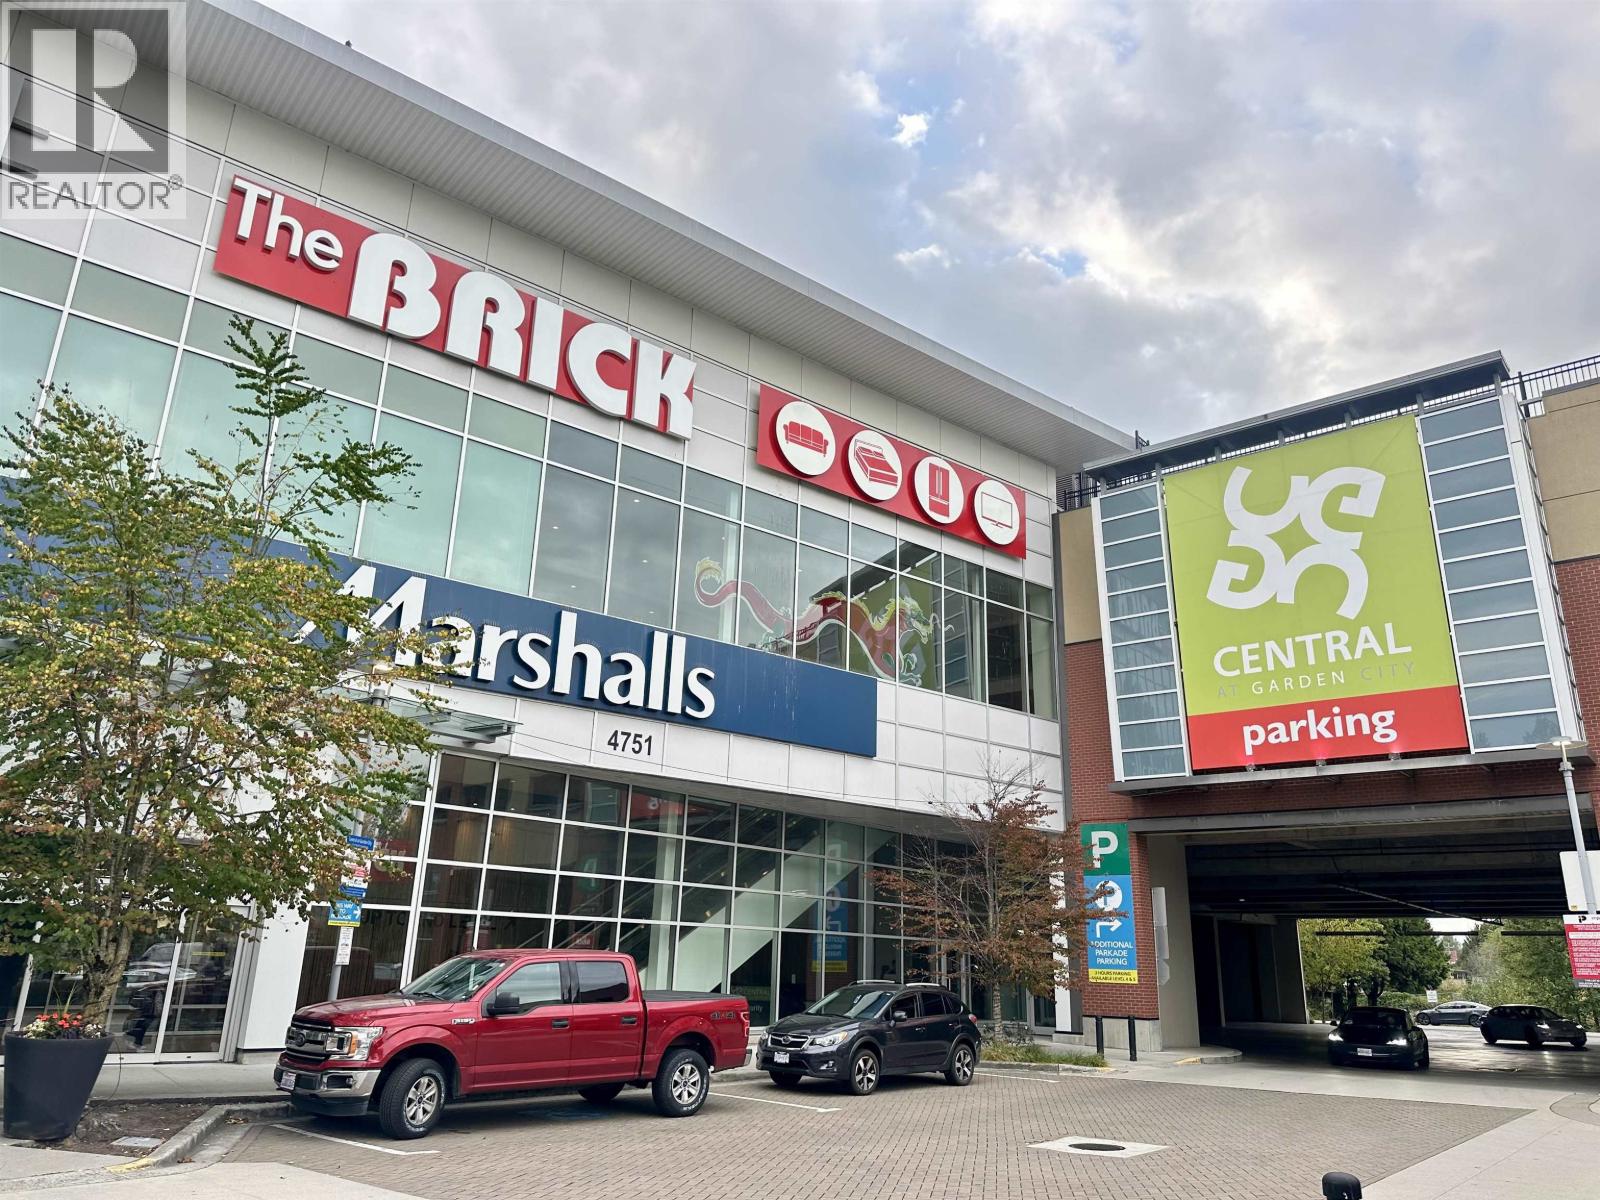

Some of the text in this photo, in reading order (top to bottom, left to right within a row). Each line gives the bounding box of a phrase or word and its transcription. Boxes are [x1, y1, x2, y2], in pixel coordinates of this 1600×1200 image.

[232, 177, 696, 440] The BRICK
[290, 565, 717, 720] Marshalls
[1213, 622, 1412, 677] CENTRAL
[1218, 661, 1415, 698] AT GARDEN CITY
[607, 729, 653, 756] 4751
[1243, 706, 1398, 756] parking
[1091, 830, 1119, 869] P
[1095, 949, 1128, 957] PARKADE
[1096, 957, 1128, 965] PARKING
